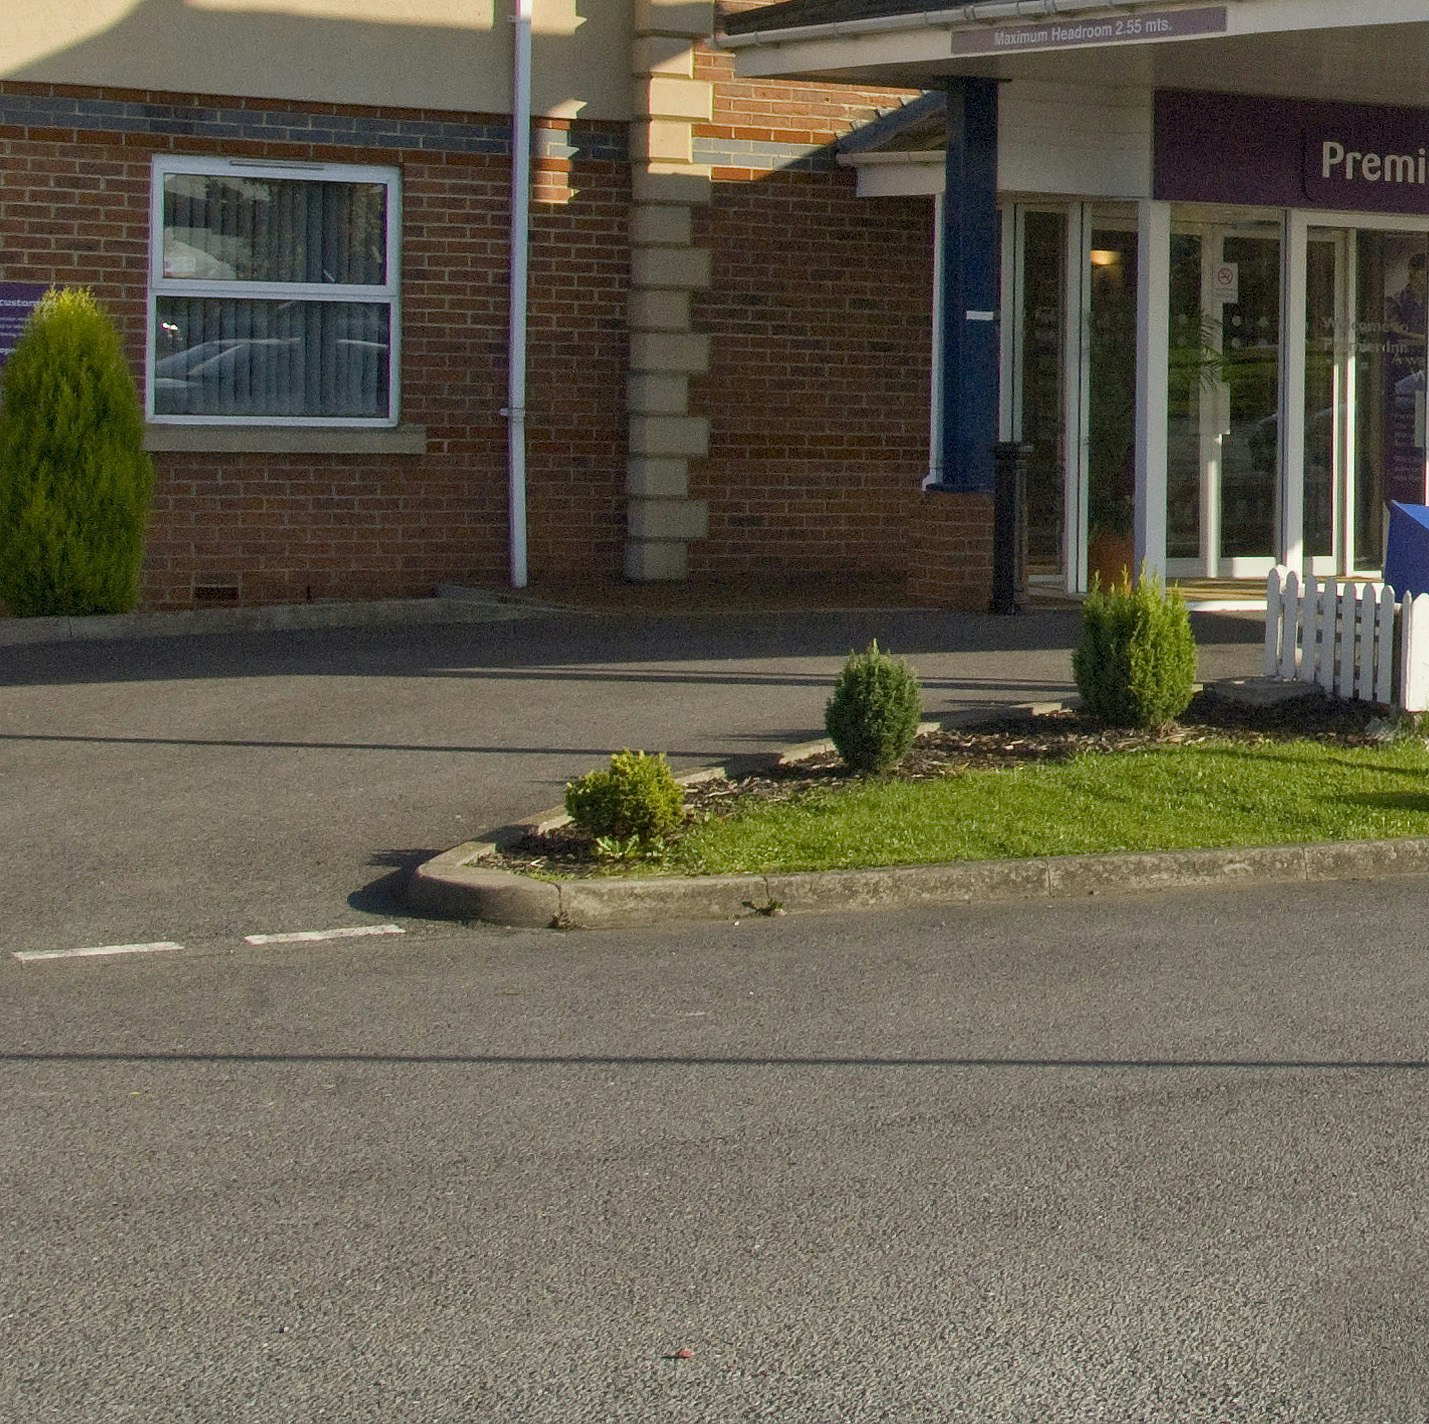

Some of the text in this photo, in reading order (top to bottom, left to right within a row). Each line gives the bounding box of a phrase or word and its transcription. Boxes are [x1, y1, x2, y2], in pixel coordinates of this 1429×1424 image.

[994, 30, 1048, 46] Maximum
[1051, 24, 1113, 42] Headroom
[1115, 19, 1142, 35] 2.55
